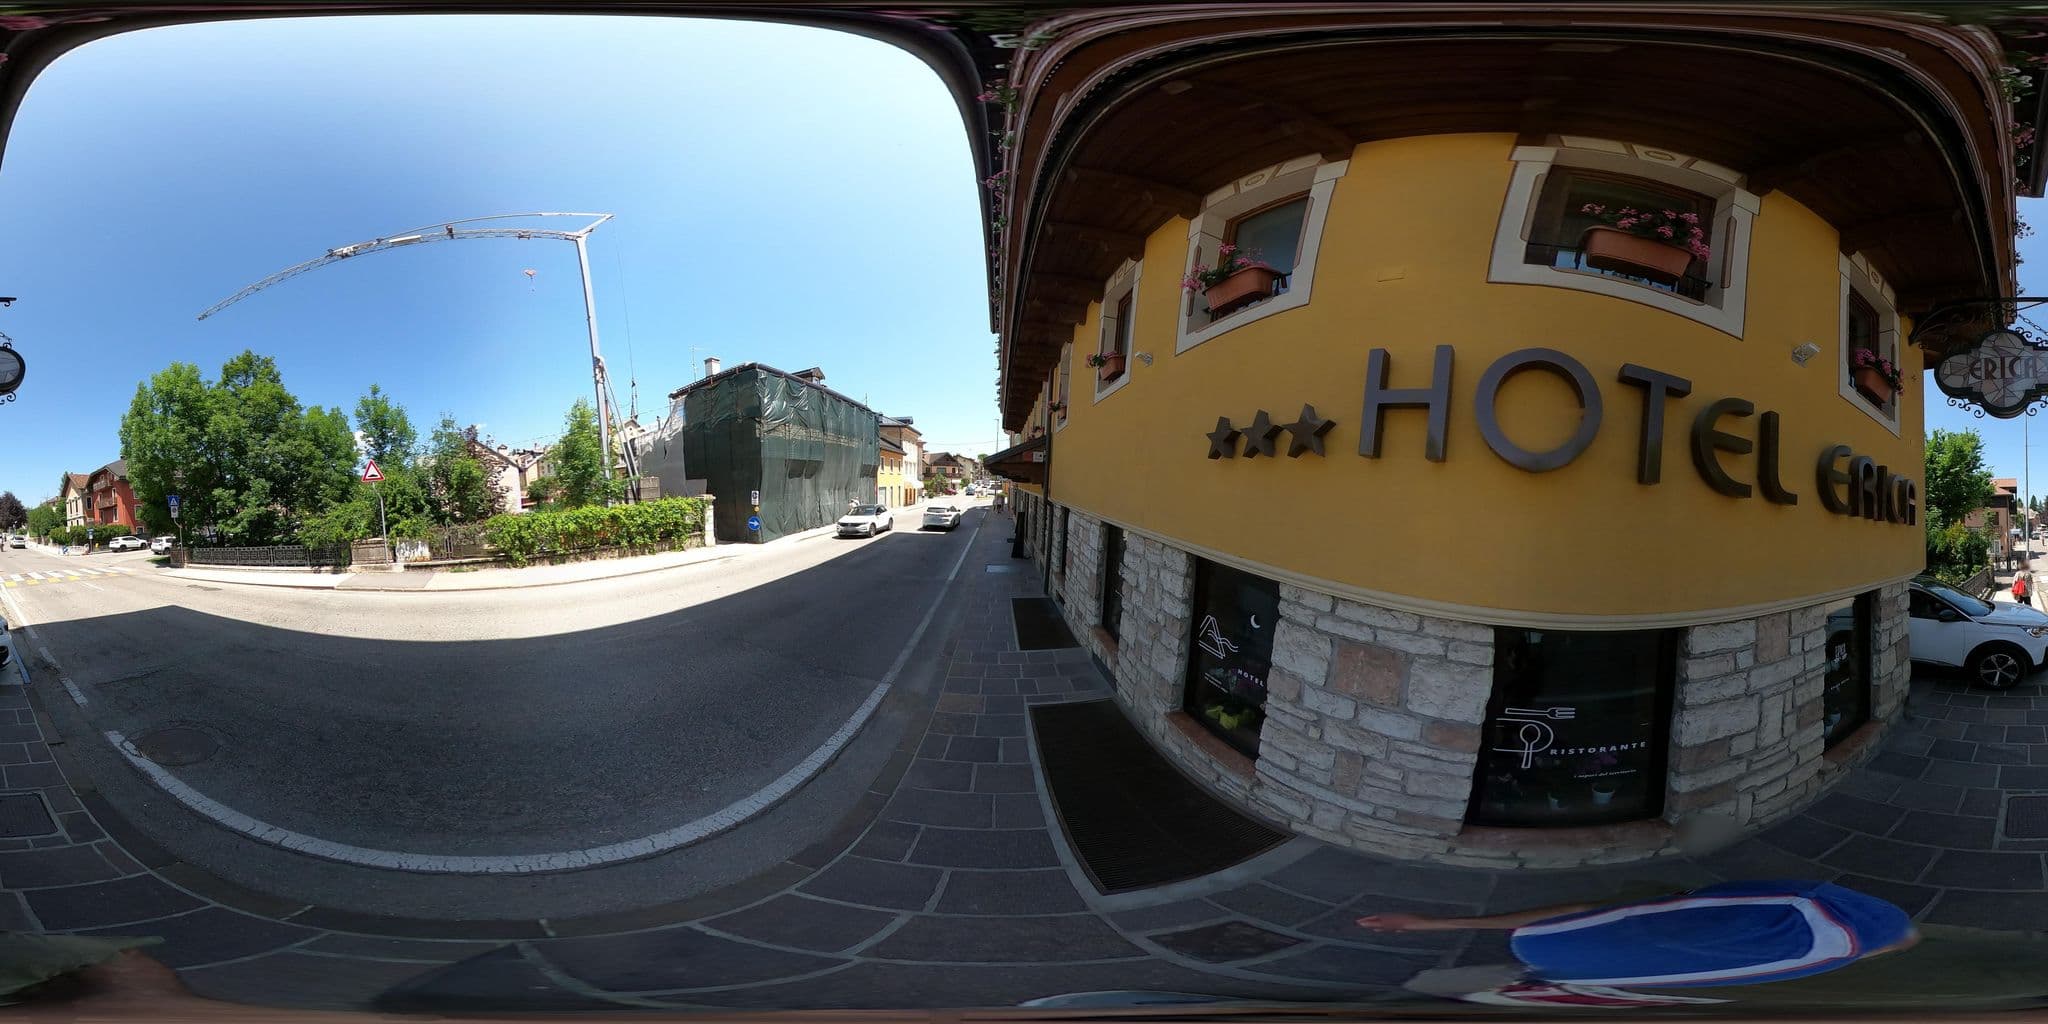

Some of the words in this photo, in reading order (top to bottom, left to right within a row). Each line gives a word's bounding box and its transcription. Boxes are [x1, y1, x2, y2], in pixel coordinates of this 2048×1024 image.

[1969, 355, 2037, 380] ERICA
[1358, 344, 1798, 506] HOTEL
[1816, 444, 1916, 526] ERICA
[1237, 668, 1264, 687] HOTEL
[1550, 741, 1646, 755] RISTORANTE
